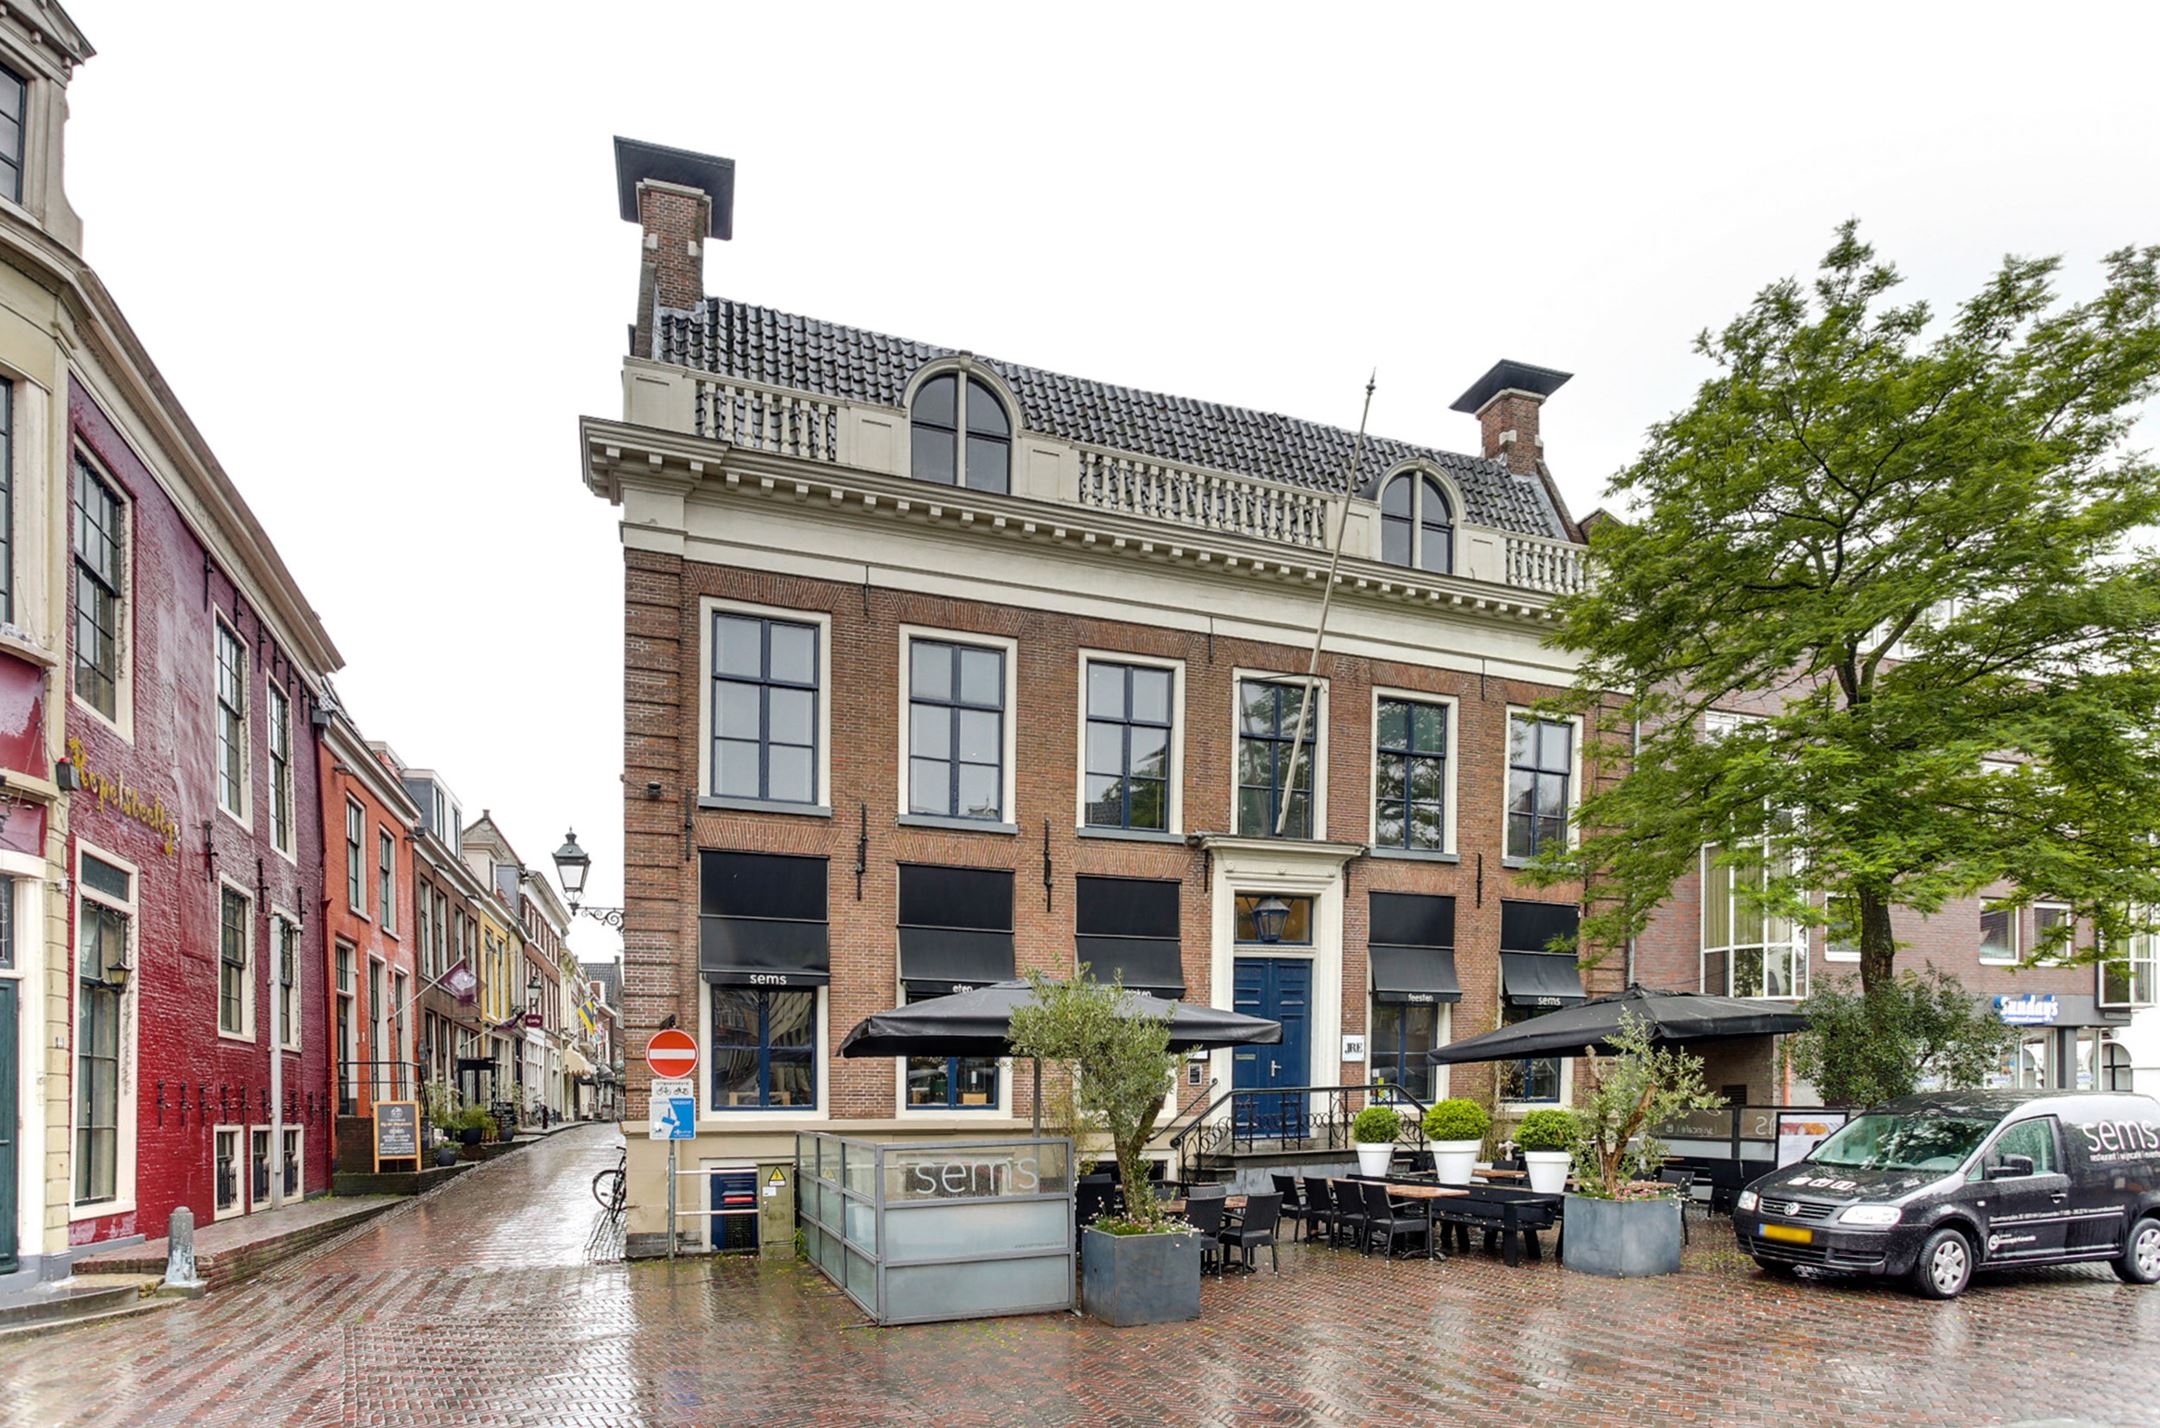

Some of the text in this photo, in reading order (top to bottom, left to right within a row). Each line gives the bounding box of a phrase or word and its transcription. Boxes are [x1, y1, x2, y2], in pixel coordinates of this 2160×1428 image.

[750, 974, 787, 985] sems
[952, 984, 973, 993] eten
[1408, 992, 1433, 1002] feesten
[1537, 996, 1561, 1006] sems
[2000, 994, 2058, 1021] Sunday's
[1344, 1042, 1363, 1054] JRE
[2082, 1119, 2159, 1152] sems
[915, 1157, 1039, 1194] sems
